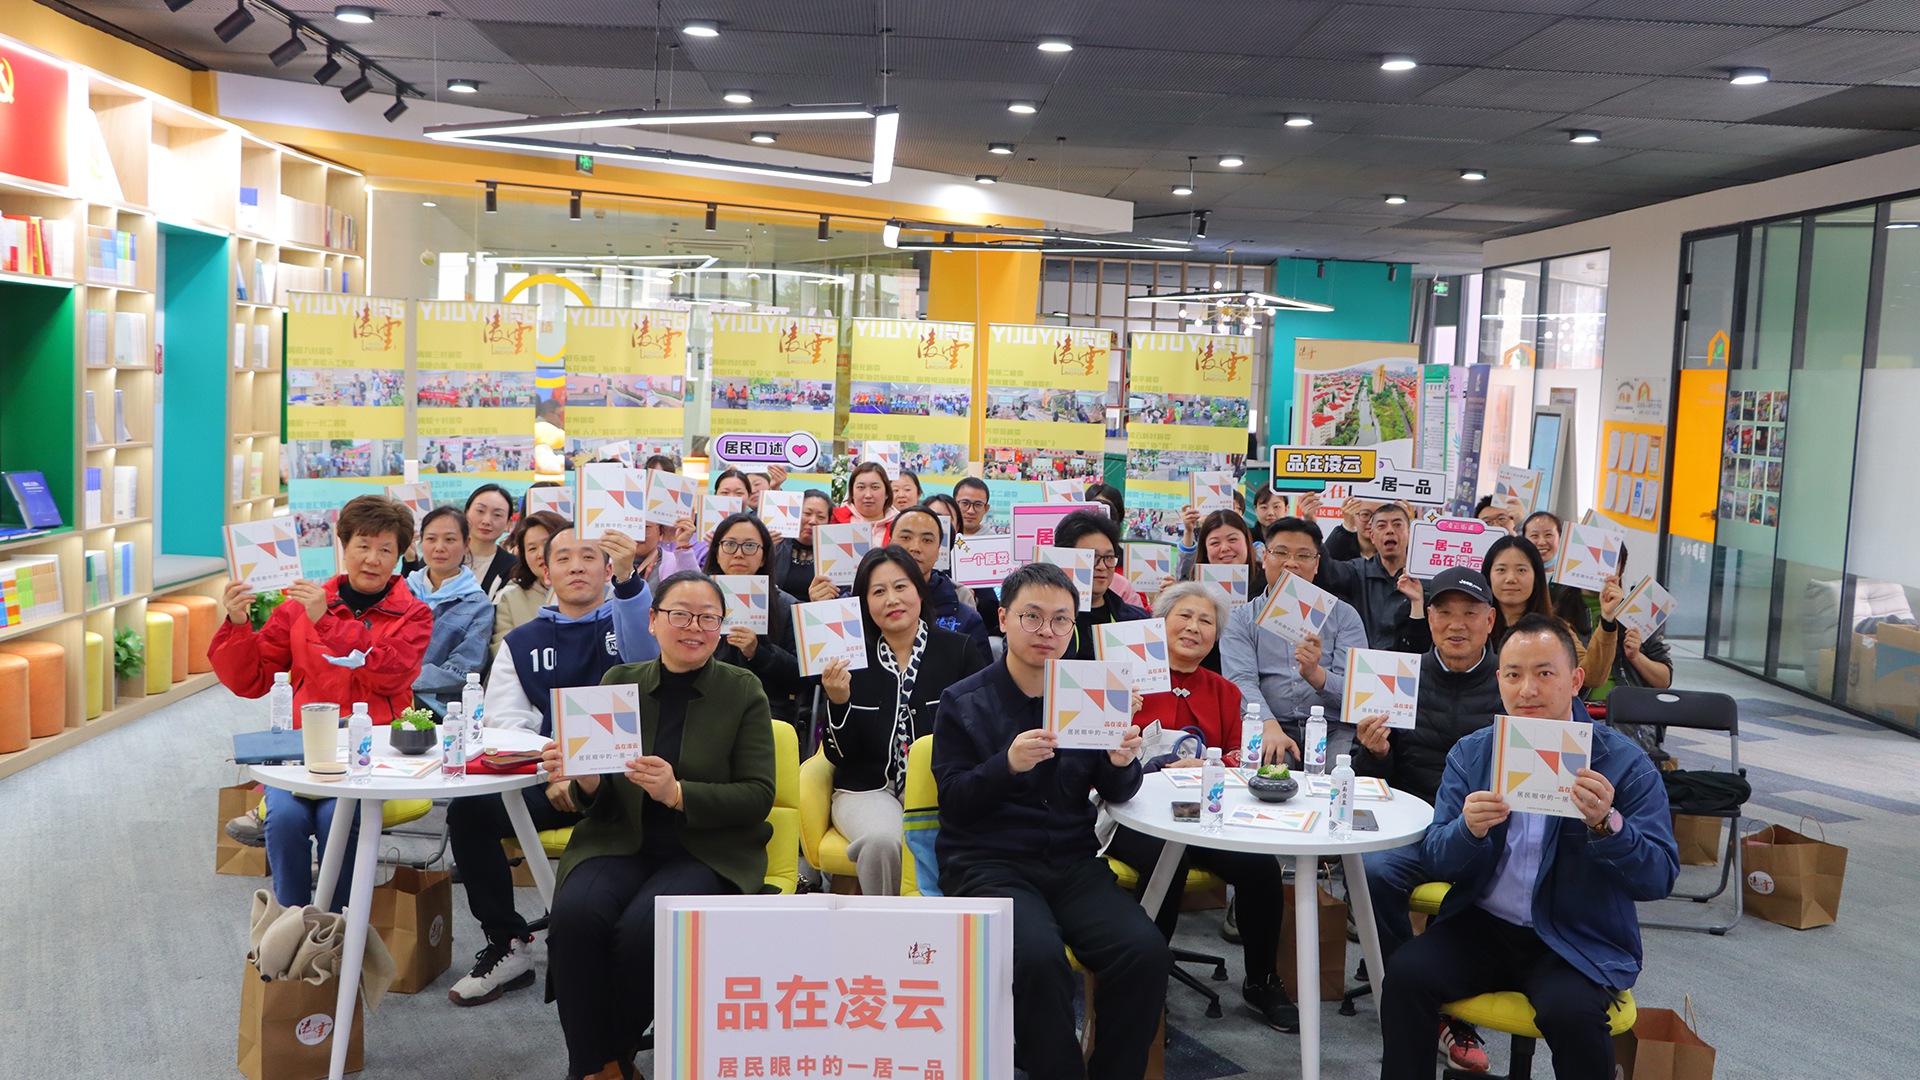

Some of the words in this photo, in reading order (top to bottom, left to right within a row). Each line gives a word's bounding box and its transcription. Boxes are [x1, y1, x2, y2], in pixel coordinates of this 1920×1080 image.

[725, 440, 783, 455] 居民口述
[1286, 453, 1361, 473] 品在凌云
[1422, 539, 1473, 554] 一居一品
[530, 647, 557, 672] 10
[717, 974, 944, 1033] 品在凌云
[717, 1055, 945, 1080] 居民眼中的一居一品
